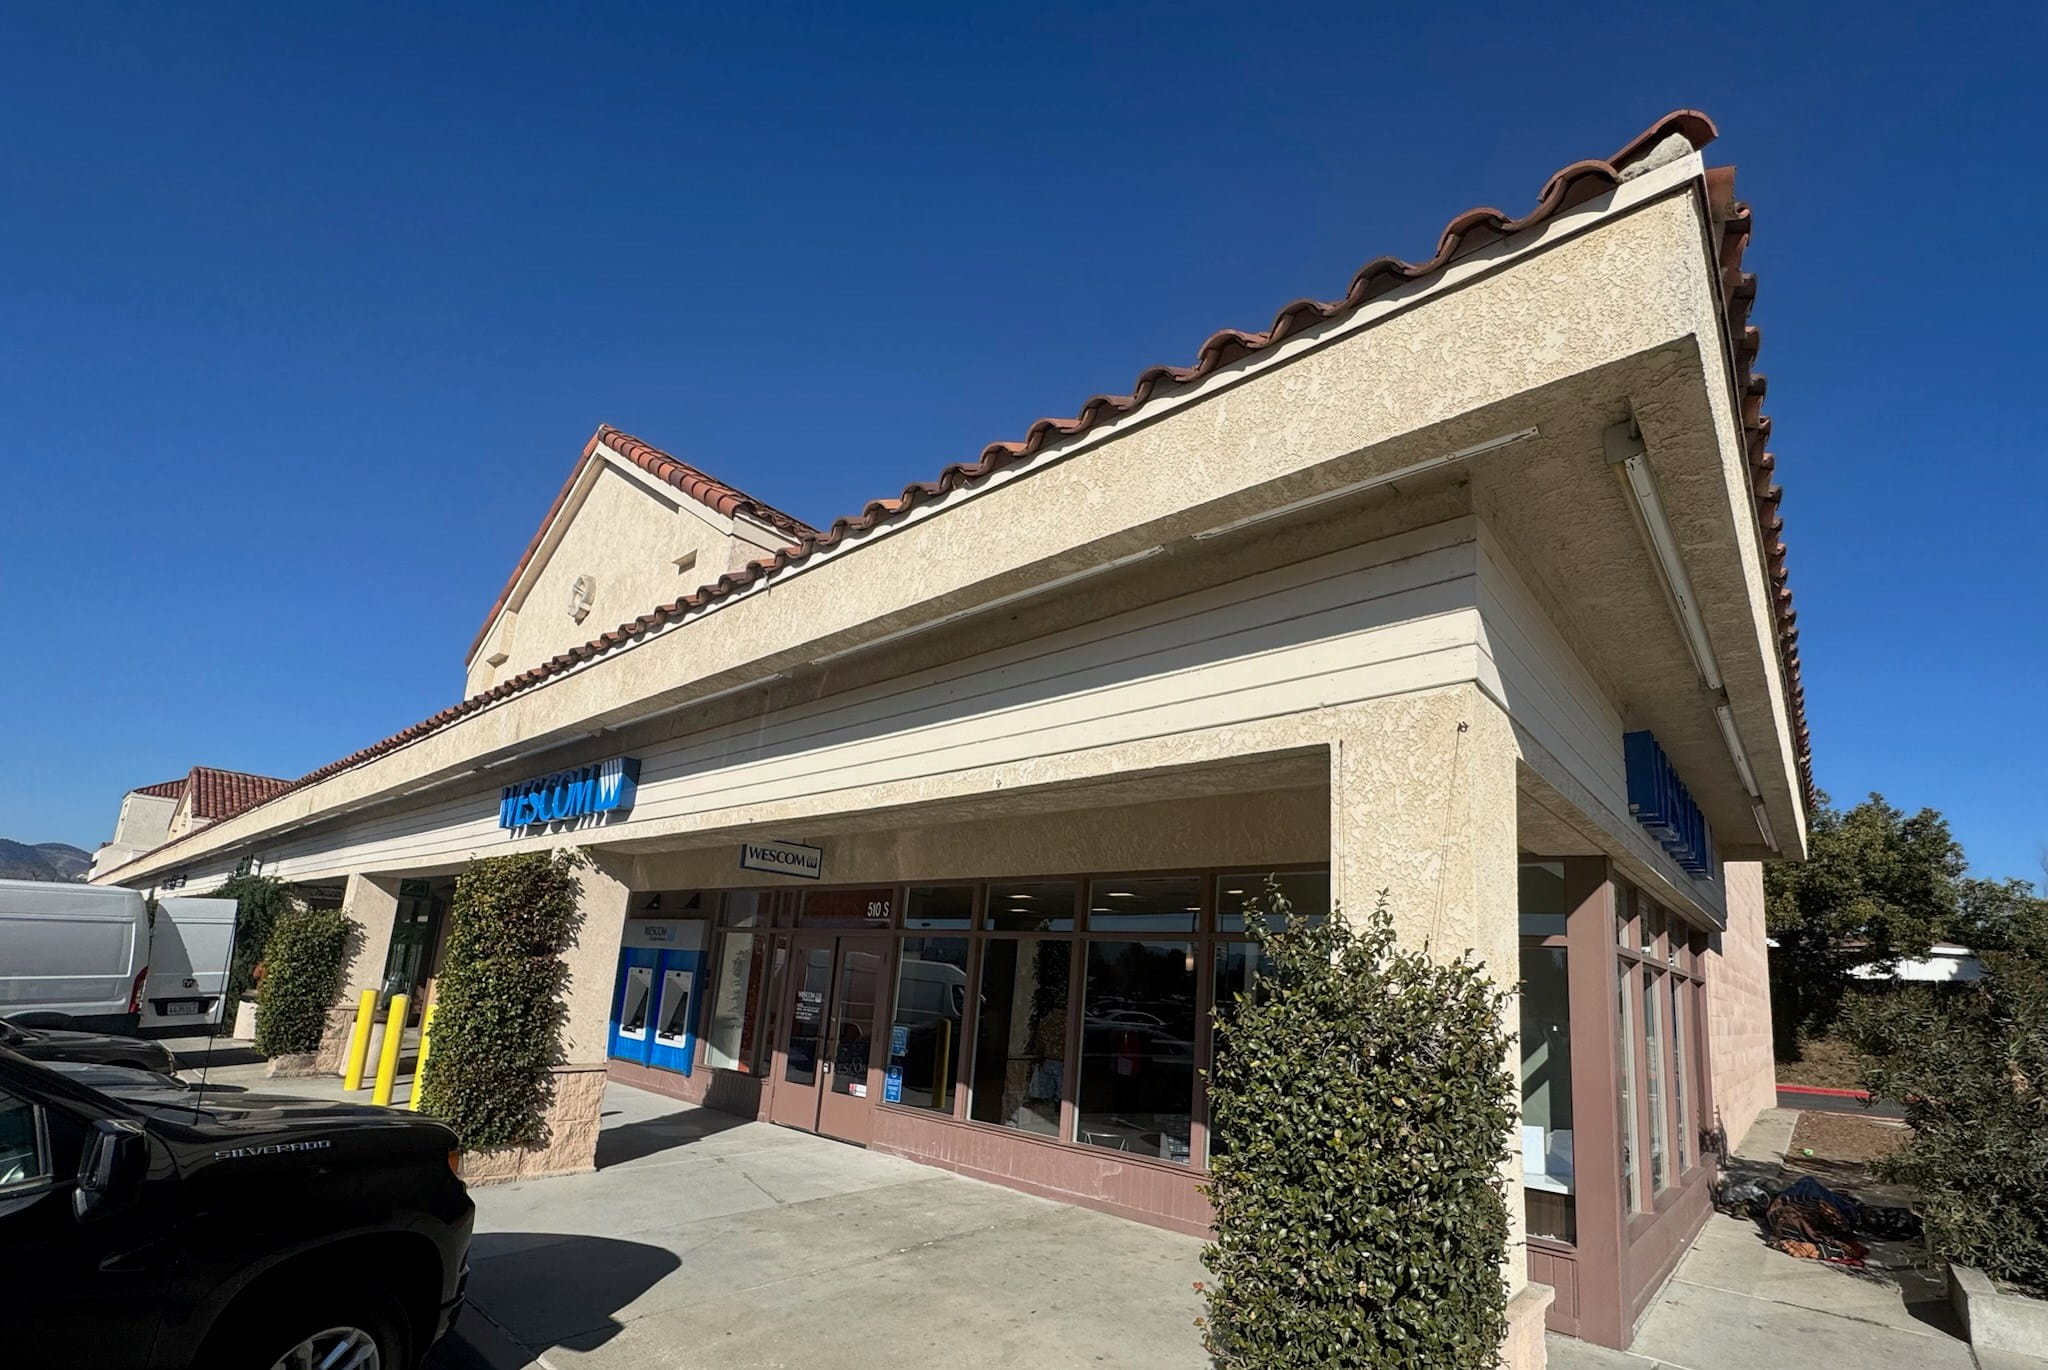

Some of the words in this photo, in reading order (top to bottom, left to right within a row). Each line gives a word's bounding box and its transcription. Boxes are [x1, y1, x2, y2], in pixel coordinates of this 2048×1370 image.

[499, 764, 601, 828] WESCOM
[749, 847, 805, 867] WESCOM
[867, 901, 881, 917] 510
[883, 901, 890, 917] S
[215, 1139, 331, 1160] SILVERADO
